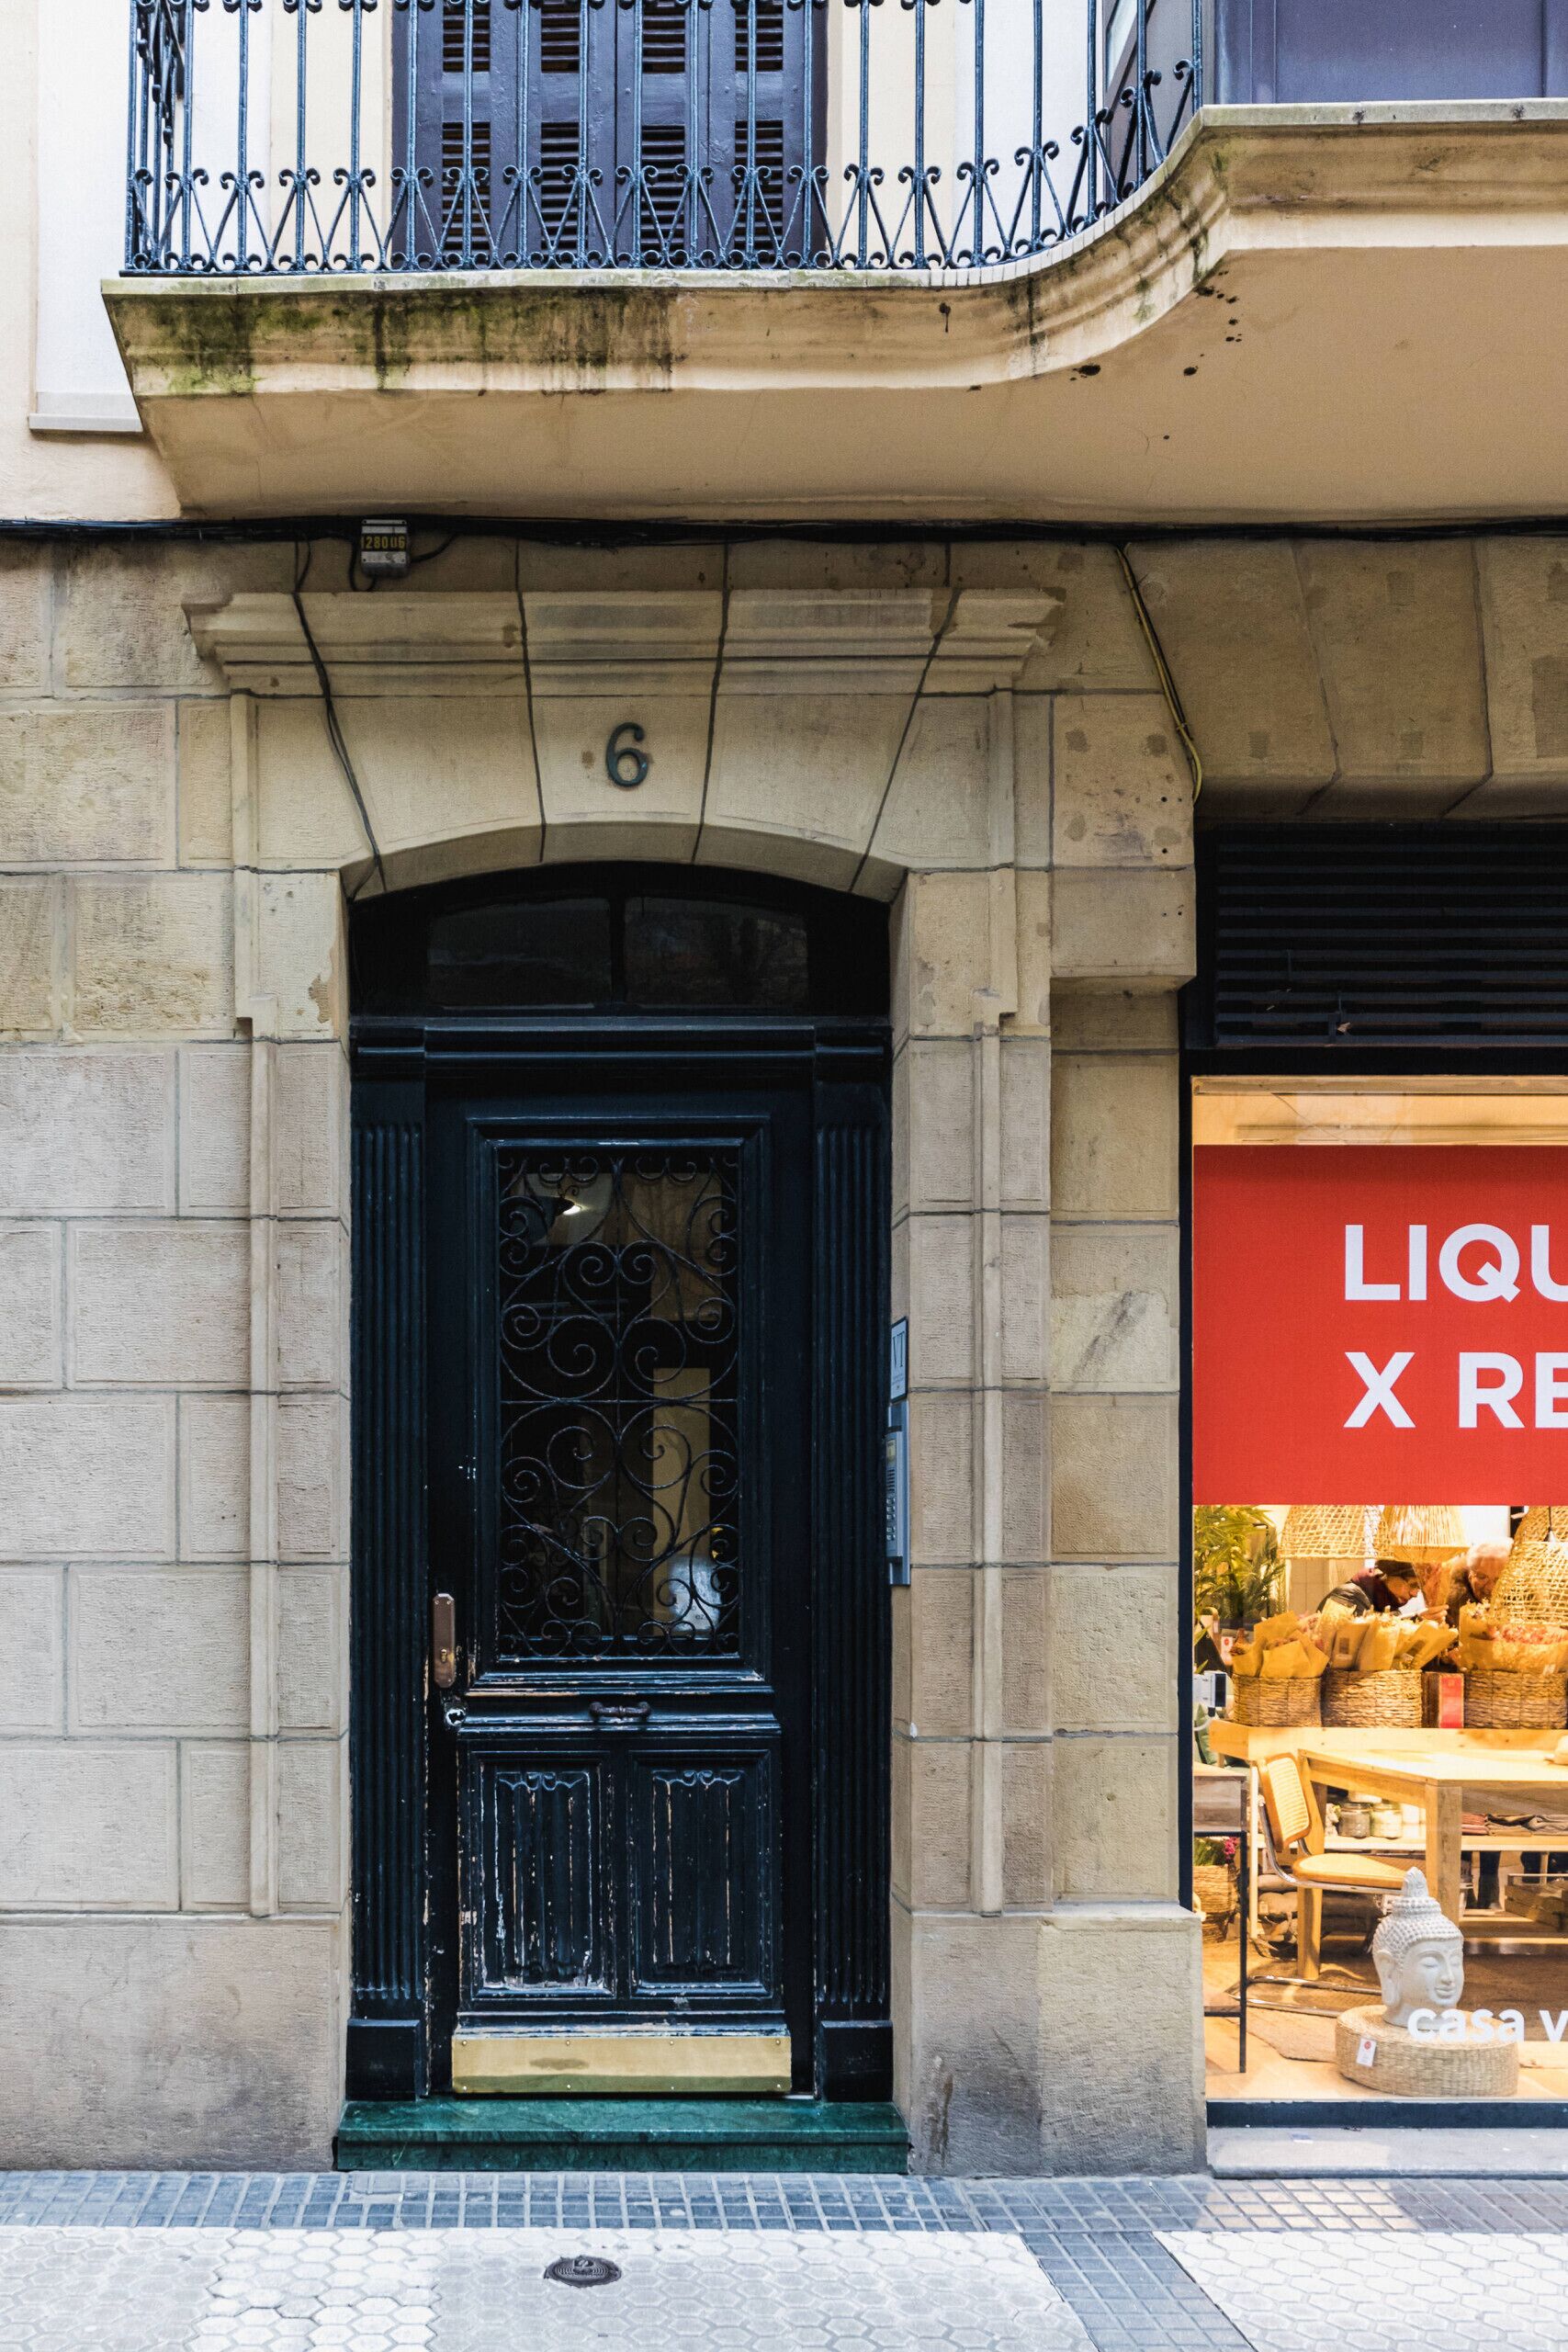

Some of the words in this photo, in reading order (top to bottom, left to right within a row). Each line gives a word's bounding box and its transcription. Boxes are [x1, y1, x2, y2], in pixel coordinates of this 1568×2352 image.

[607, 721, 649, 787] 6
[1344, 1223, 1568, 1303] LIQU
[1344, 1351, 1416, 1429] X
[1459, 1351, 1568, 1429] RE
[1407, 2008, 1525, 2043] casa
